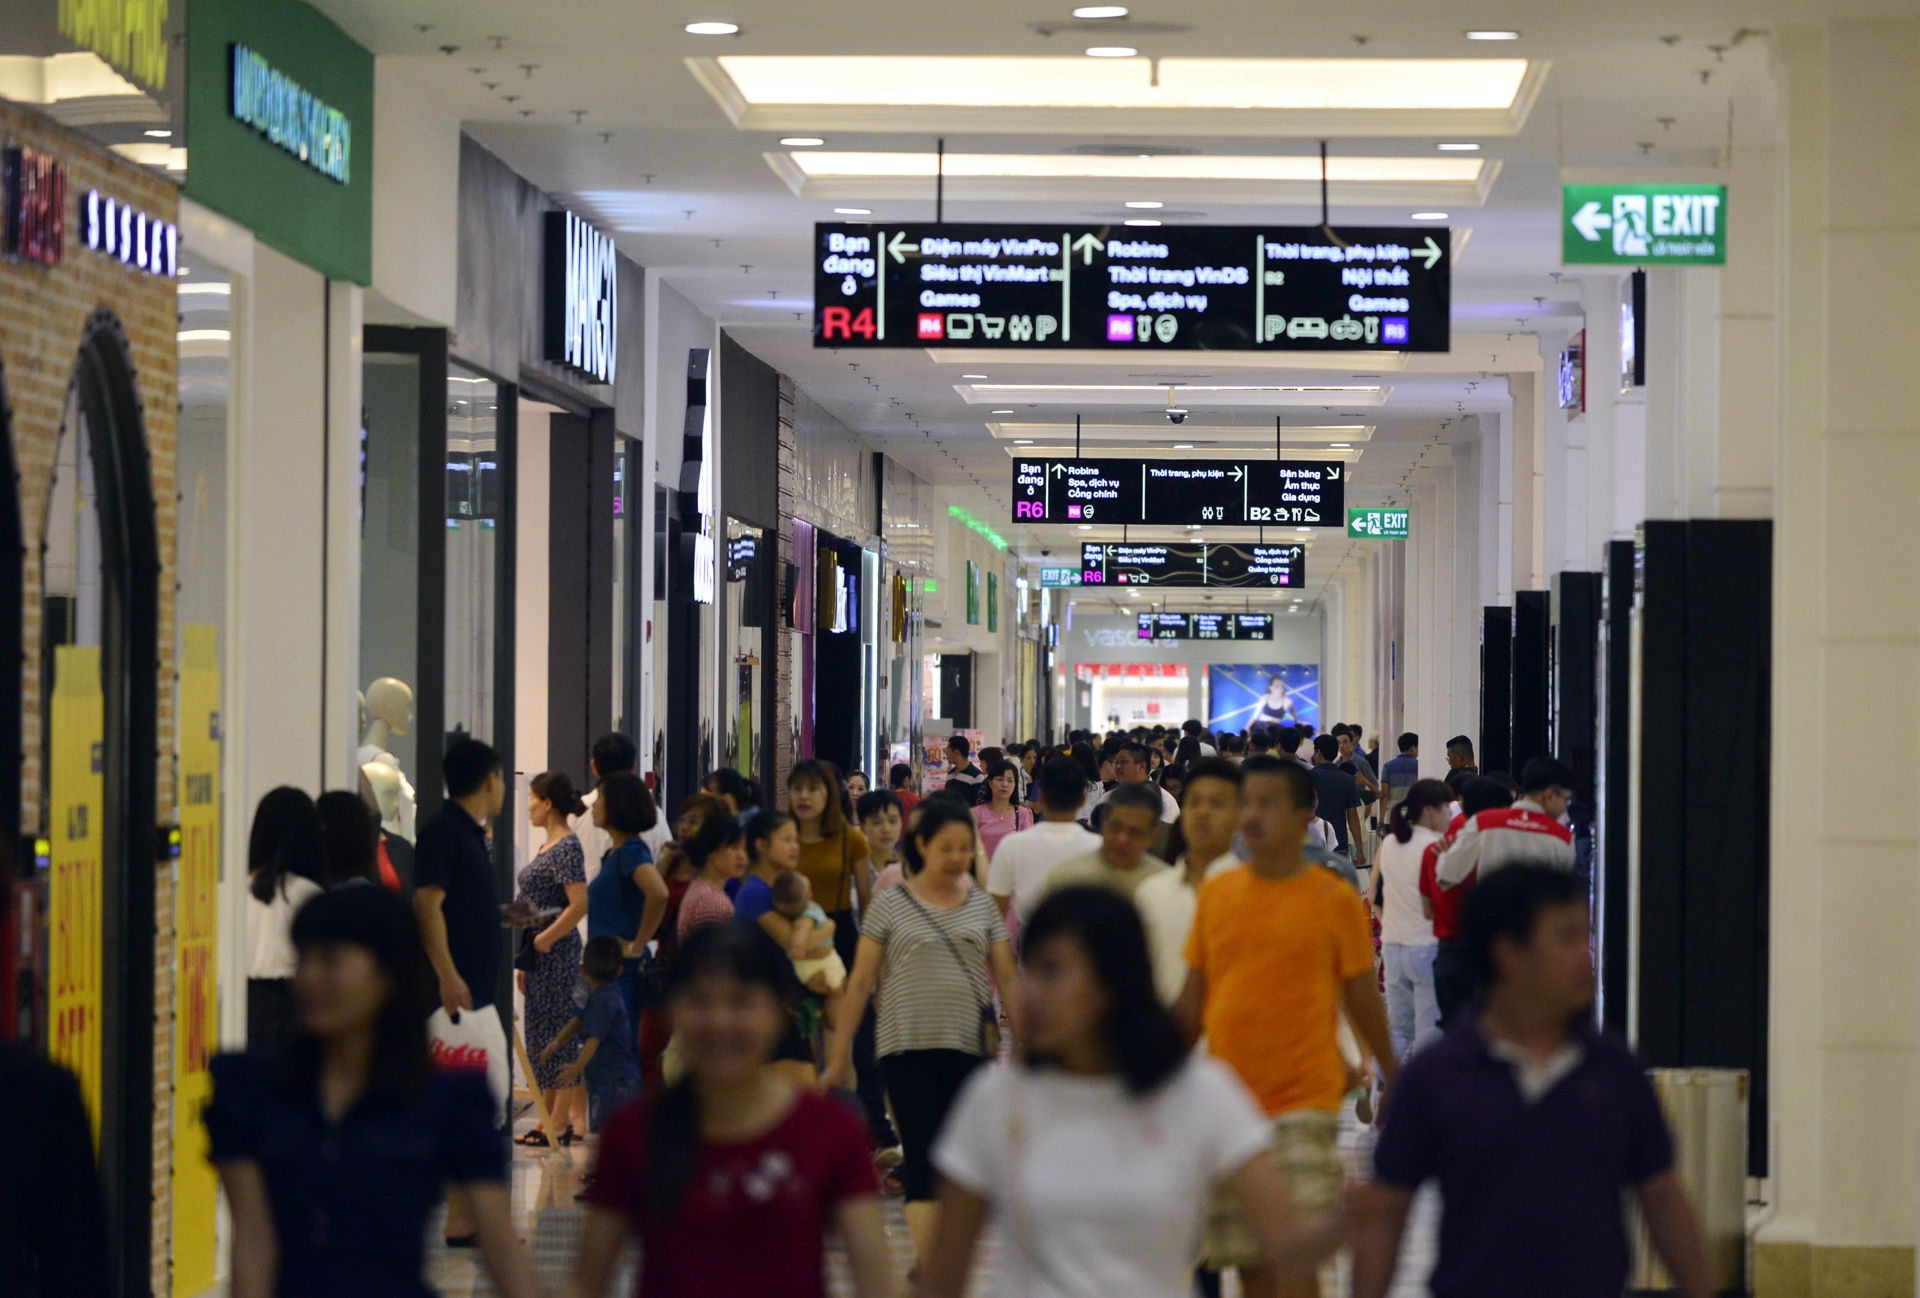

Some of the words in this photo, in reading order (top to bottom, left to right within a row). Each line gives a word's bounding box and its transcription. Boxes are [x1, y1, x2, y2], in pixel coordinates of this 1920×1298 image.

[1652, 194, 1720, 236] EXIT
[828, 233, 870, 256] Bạn
[963, 238, 1000, 258] máy
[1001, 238, 1059, 255] VinPro
[1107, 240, 1169, 258] Robins
[823, 255, 875, 277] đang
[984, 264, 1049, 282] VinMart
[1148, 266, 1196, 287] trang
[565, 210, 617, 385] MANGO
[920, 290, 981, 308] Games
[1348, 294, 1410, 312] Games
[823, 305, 877, 340] R4
[1020, 464, 1041, 475] Bạn
[1068, 466, 1099, 476] Robins
[1150, 469, 1167, 477] Thời
[1168, 469, 1190, 479] trang,
[1191, 469, 1207, 479] phụ
[1207, 469, 1224, 478] kiện
[1280, 469, 1297, 478] Sân
[1017, 475, 1044, 486] đang
[1068, 478, 1088, 488] Spa,
[1089, 478, 1109, 488] dịch
[1109, 480, 1119, 488] vụ
[1301, 481, 1320, 490] thực
[1027, 485, 1035, 495] ở
[1093, 490, 1118, 498] chính
[1282, 493, 1296, 502] Gia
[1297, 493, 1321, 503] dụng
[1017, 501, 1043, 518] R6
[1250, 507, 1271, 520] B2
[1384, 513, 1408, 528] EXIT
[1086, 545, 1101, 553] Bạn
[1084, 553, 1102, 561] đang
[1042, 569, 1060, 580] EXIT
[1083, 570, 1102, 582] R6
